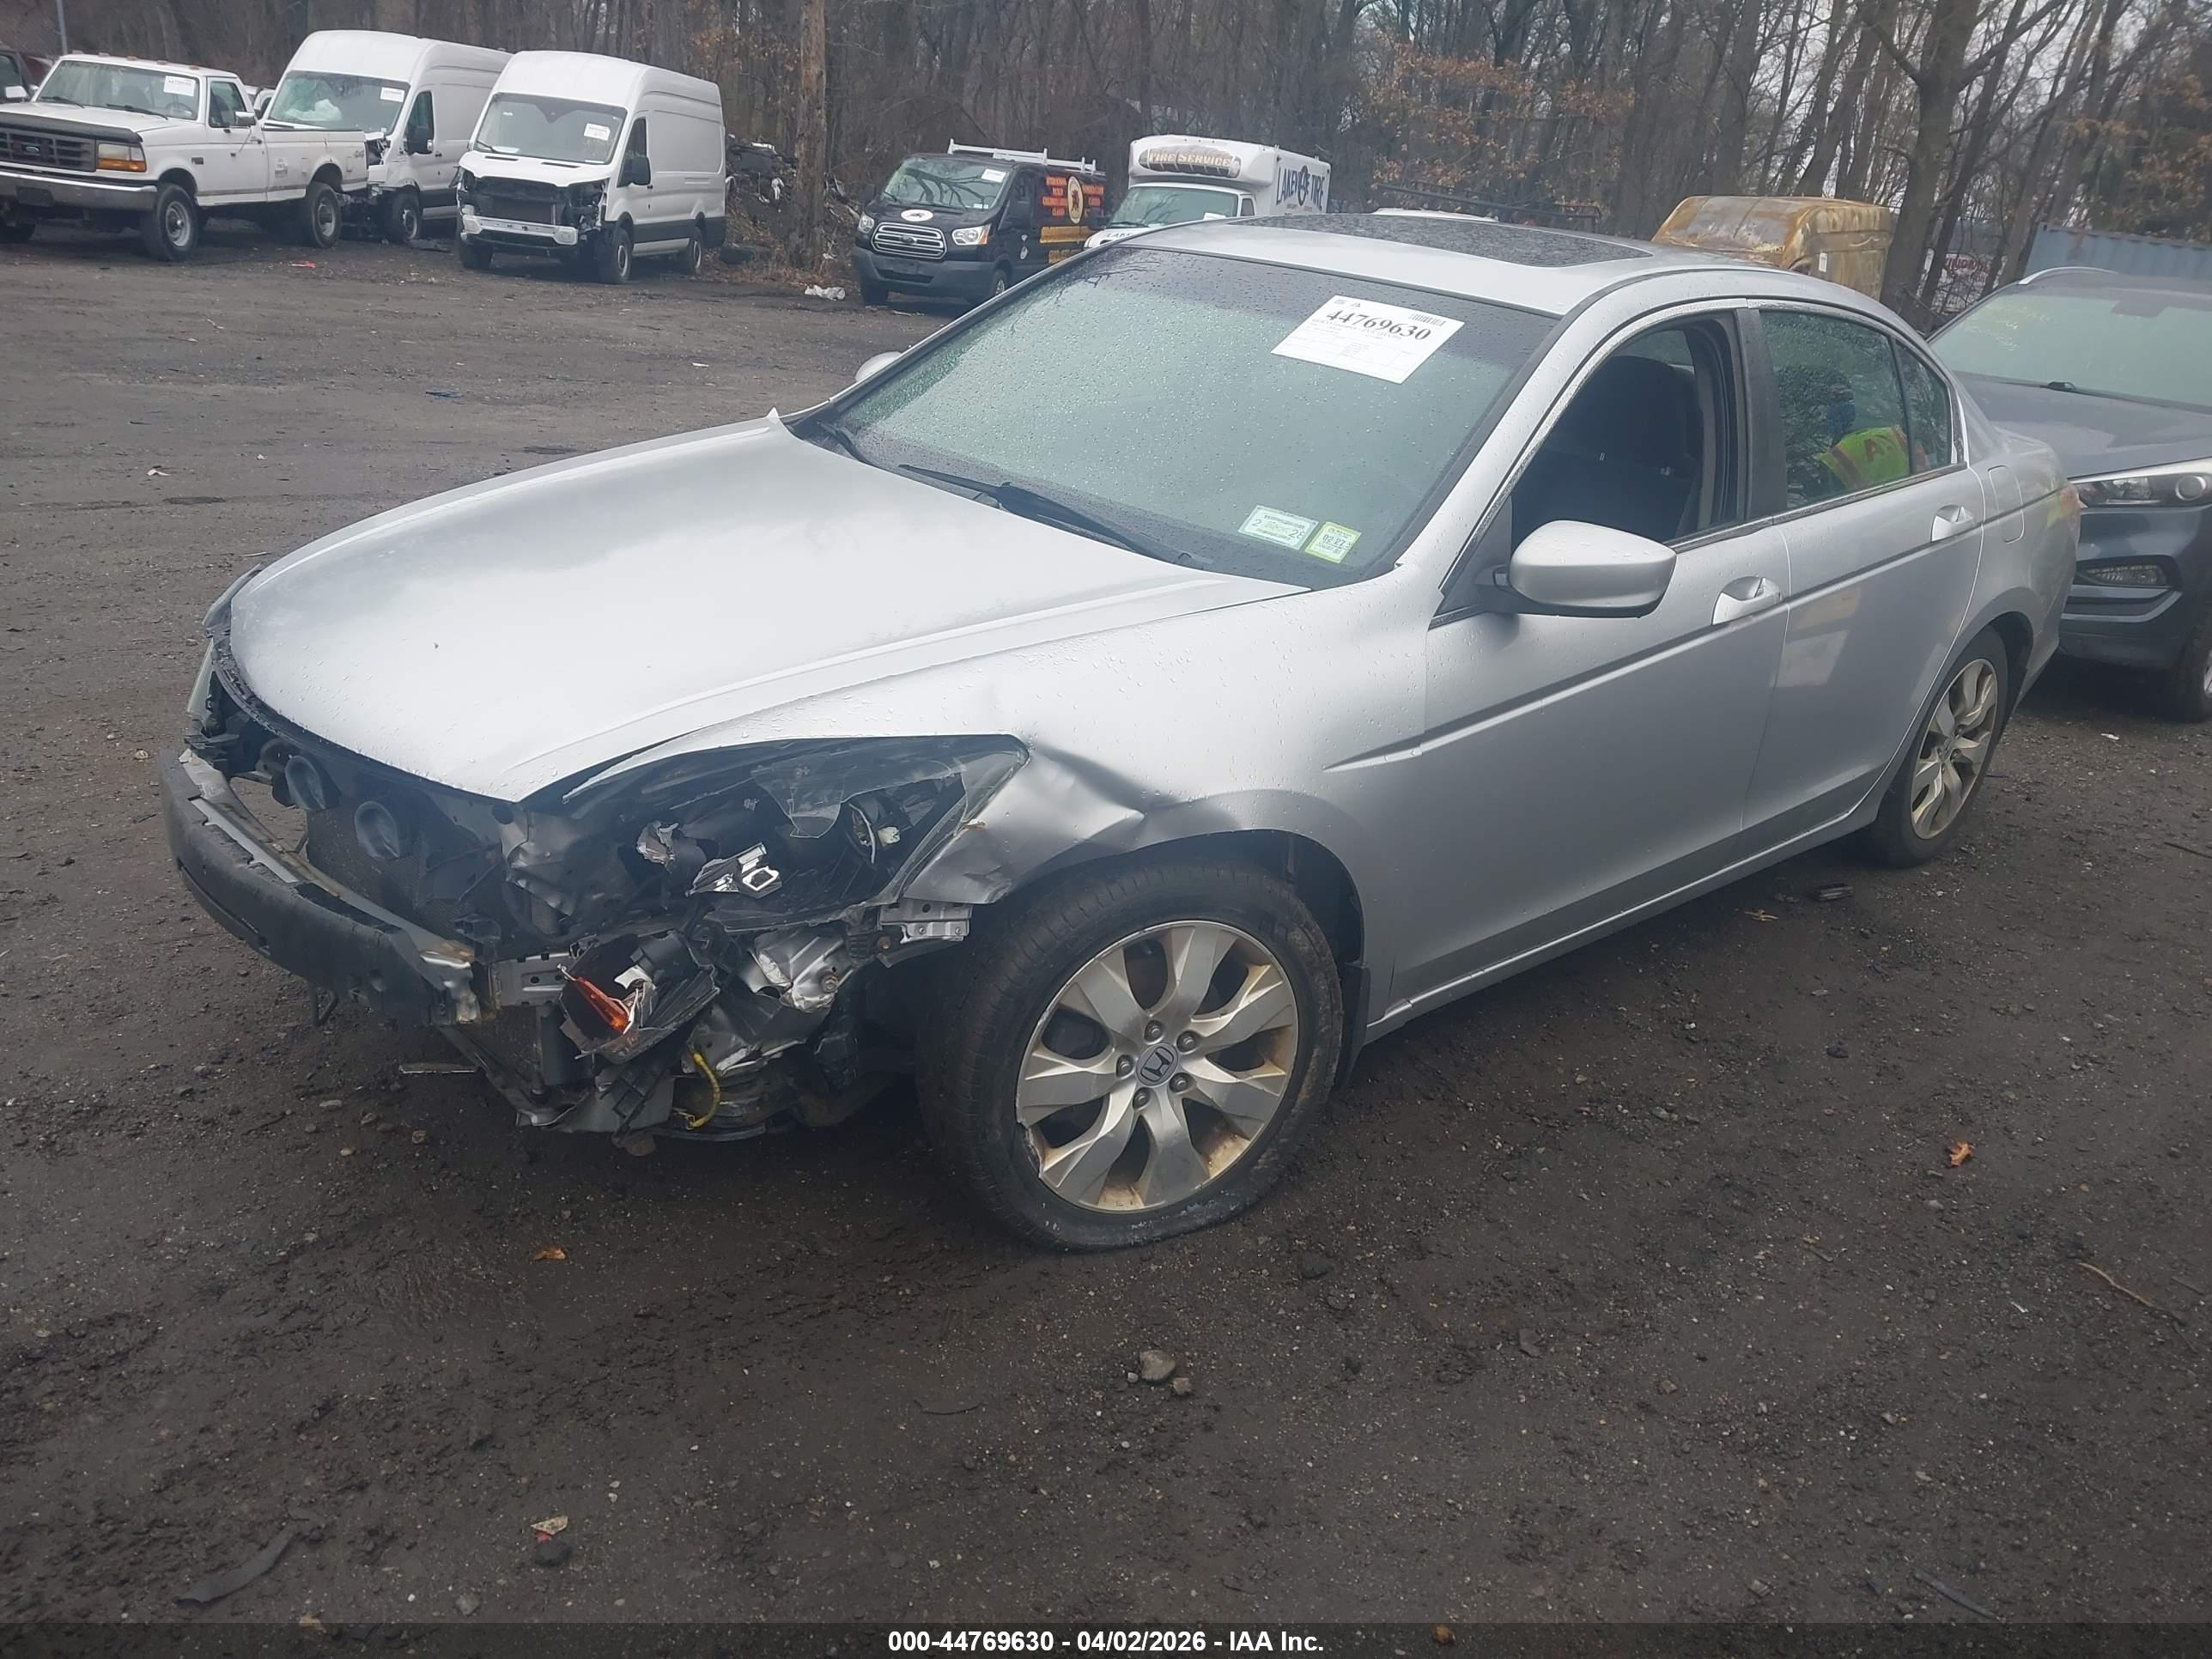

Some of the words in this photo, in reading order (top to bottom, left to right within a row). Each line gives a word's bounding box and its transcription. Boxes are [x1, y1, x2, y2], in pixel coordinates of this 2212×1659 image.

[1177, 152, 1231, 167] SERVICE
[1311, 174, 1326, 212] TIRE
[1326, 310, 1431, 341] 44769630
